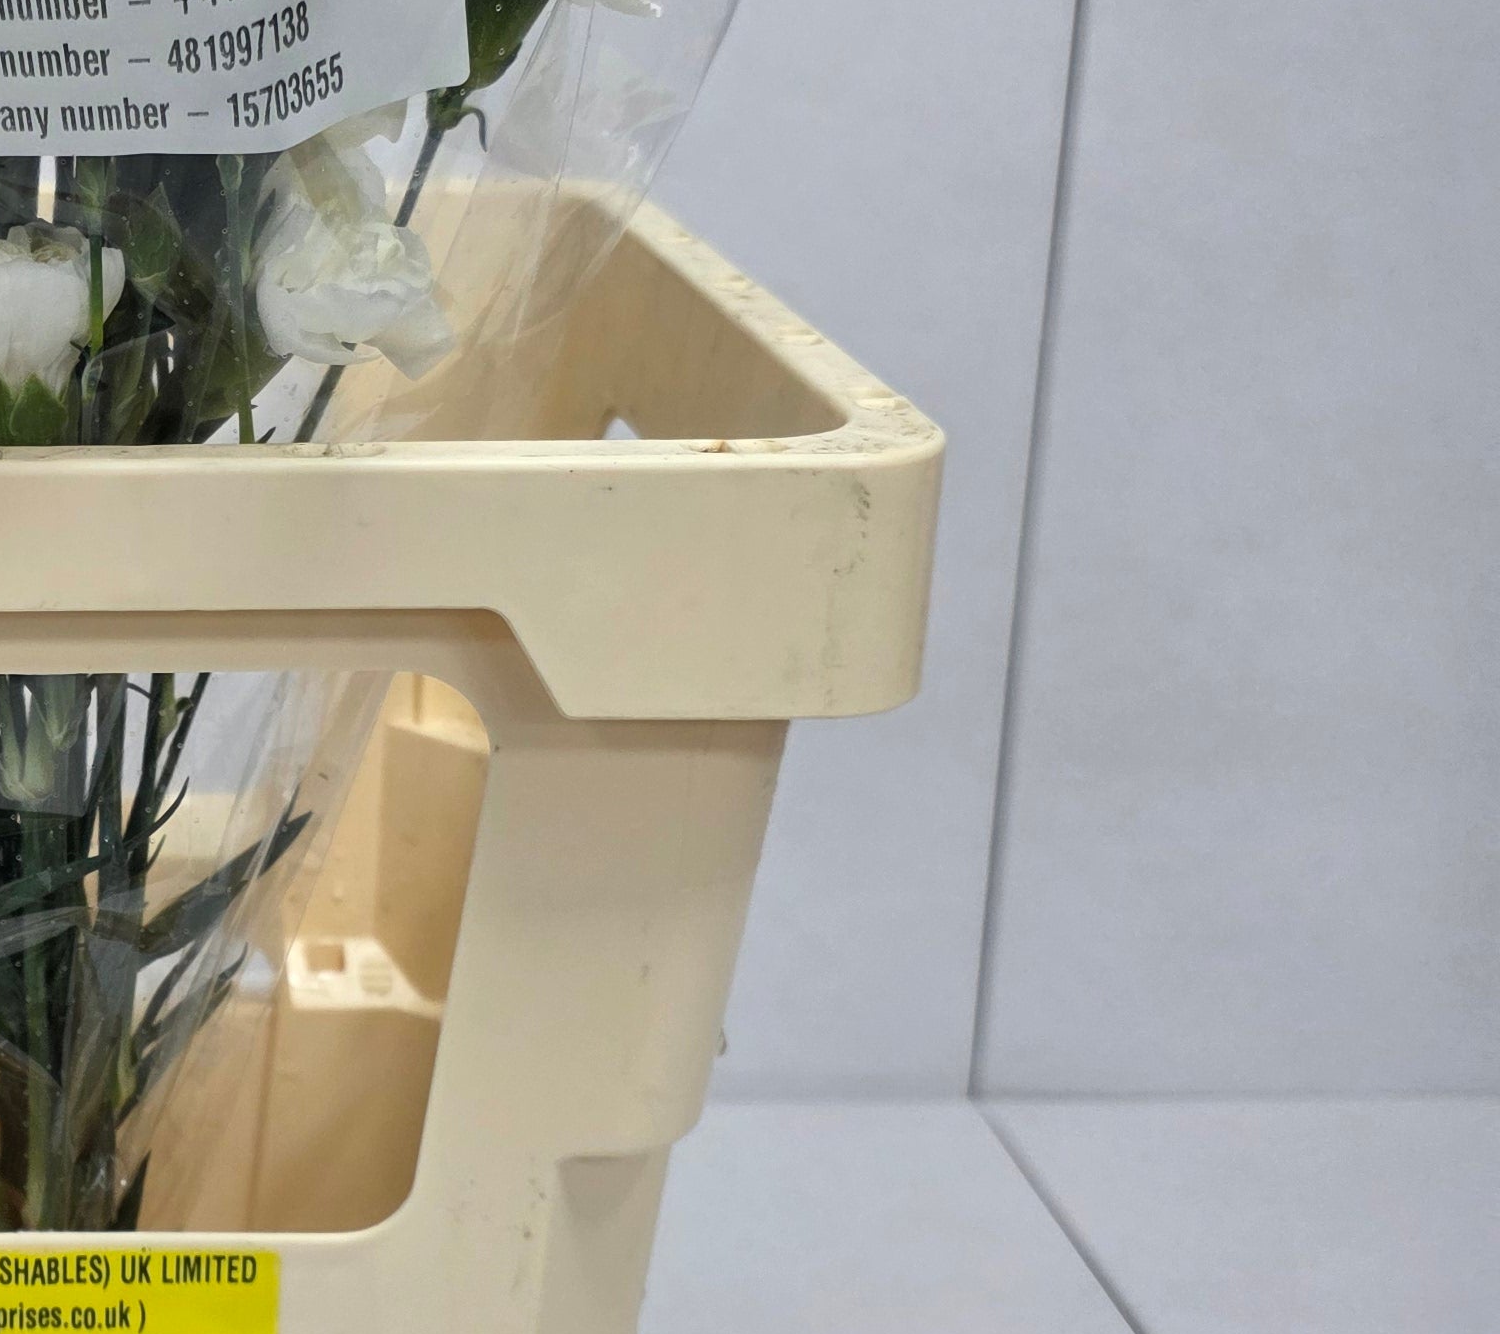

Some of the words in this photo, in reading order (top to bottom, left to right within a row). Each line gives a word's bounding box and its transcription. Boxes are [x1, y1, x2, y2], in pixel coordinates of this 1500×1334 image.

[0, 43, 110, 77] number
[168, 0, 309, 73] 481997138
[61, 97, 169, 131] number
[227, 52, 343, 127] 15703655
[121, 1255, 151, 1284] UK
[162, 1255, 256, 1284] LIMITED
[138, 1300, 146, 1334] )
